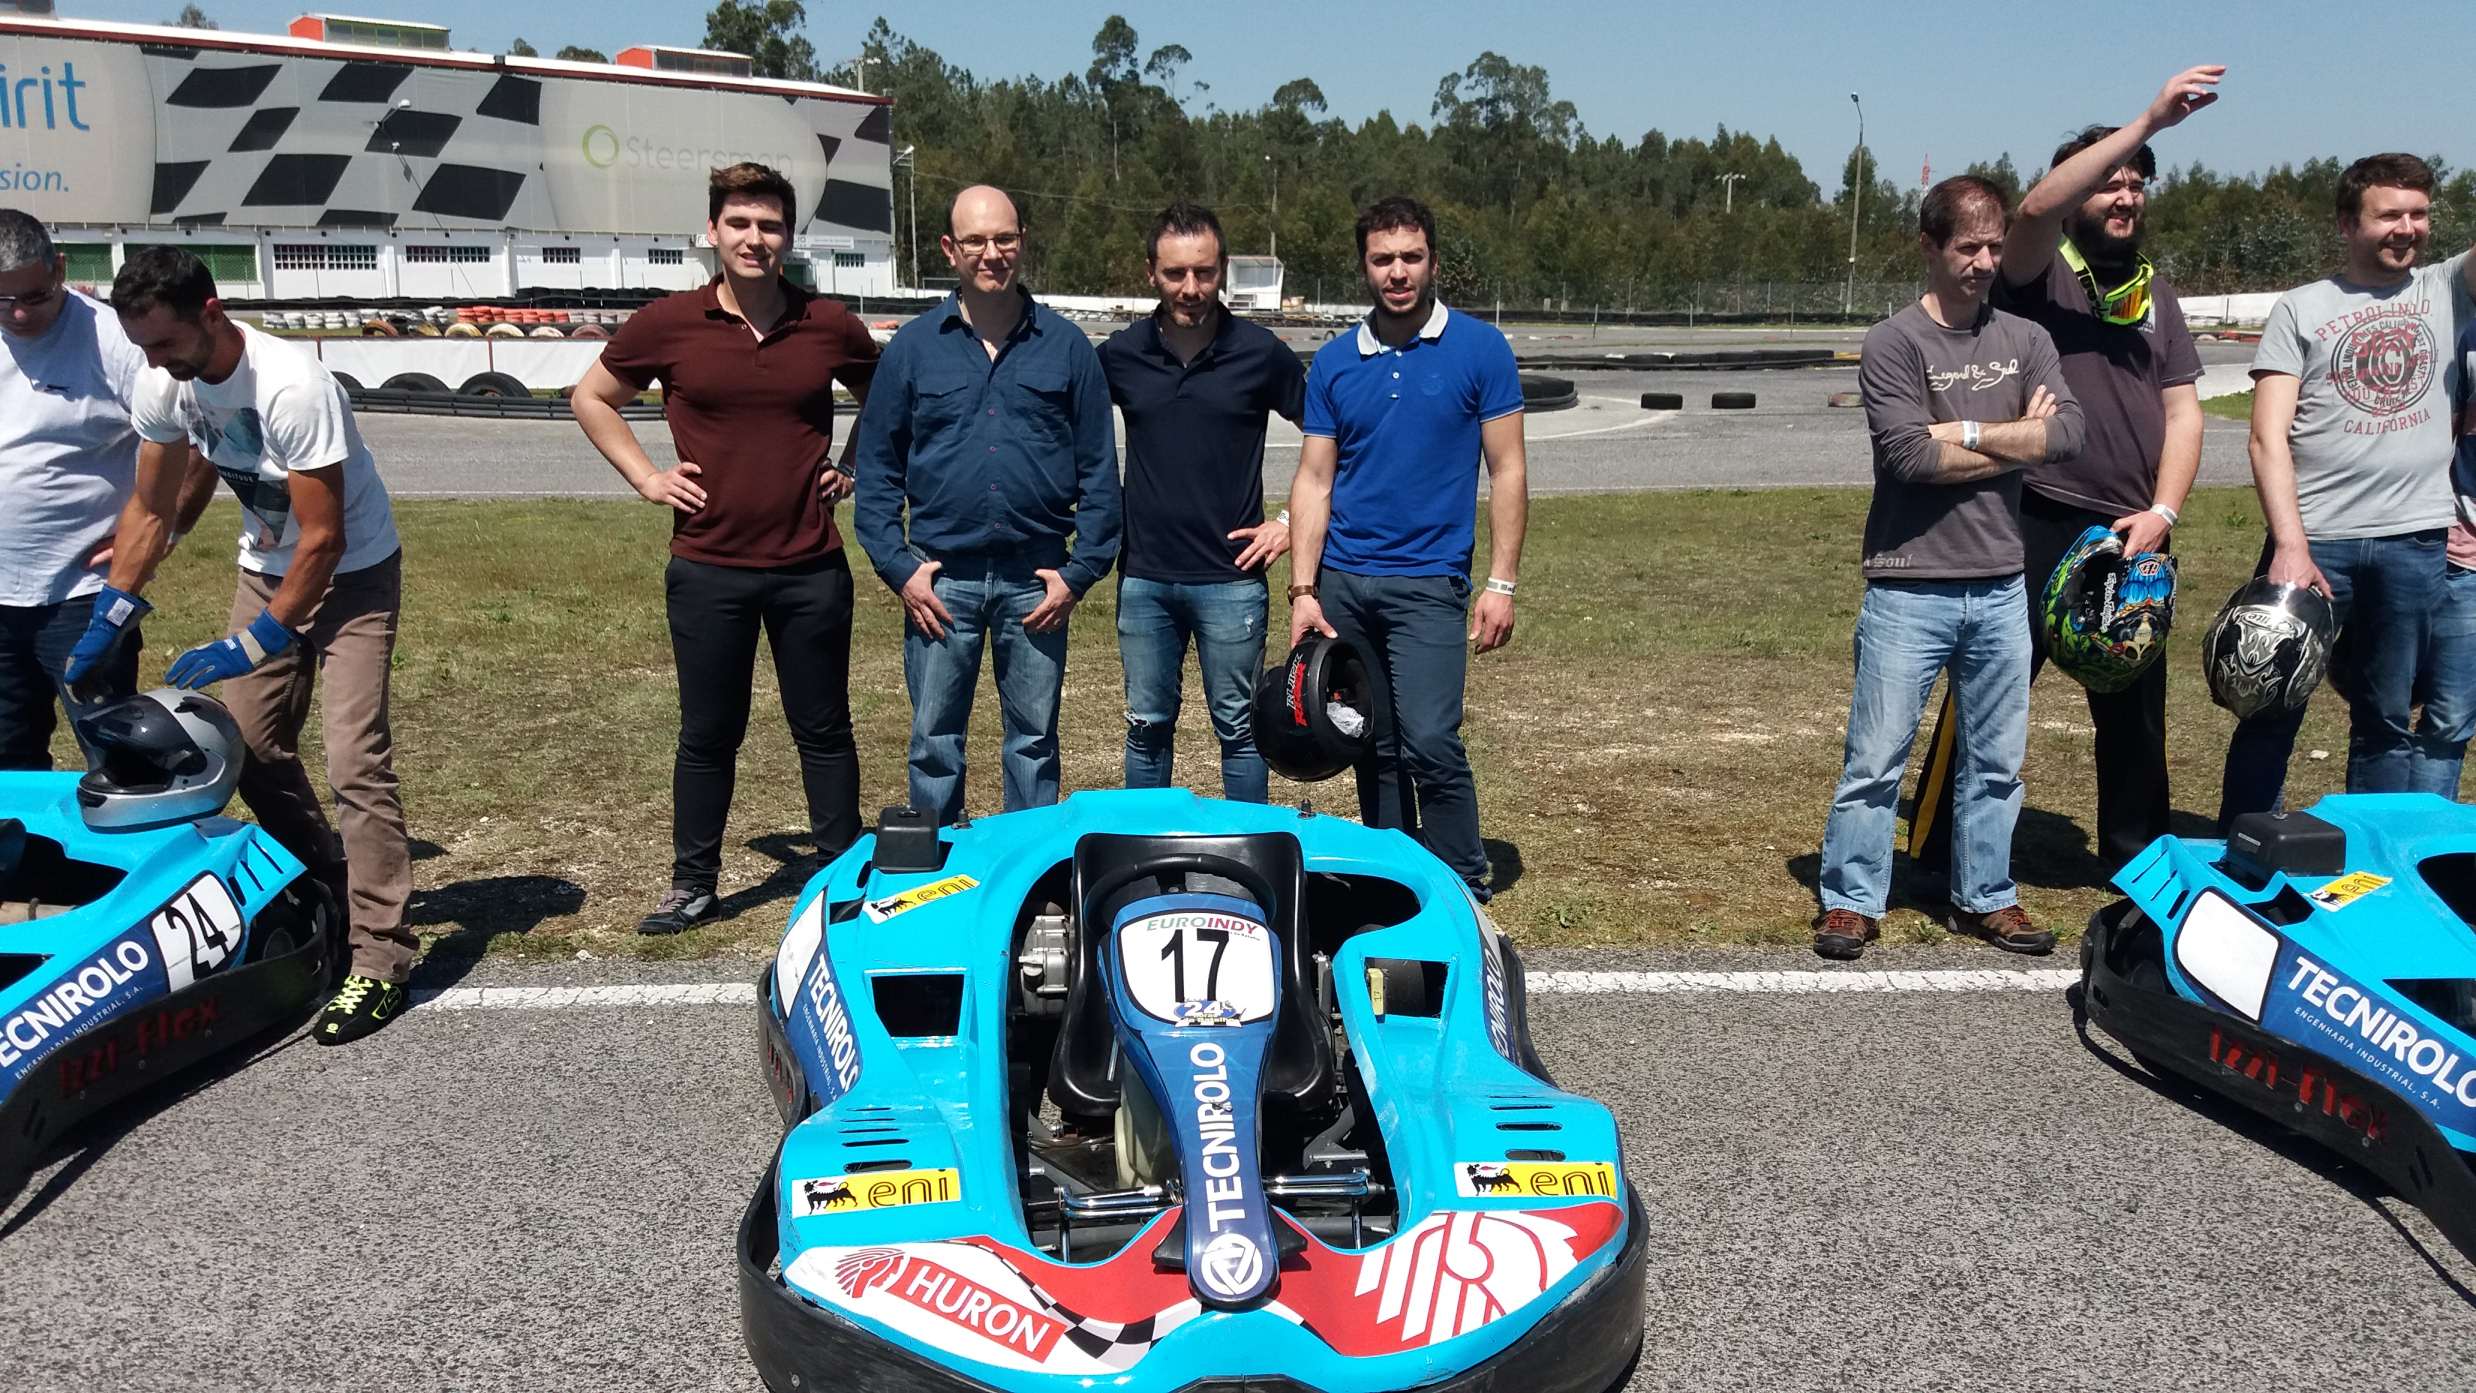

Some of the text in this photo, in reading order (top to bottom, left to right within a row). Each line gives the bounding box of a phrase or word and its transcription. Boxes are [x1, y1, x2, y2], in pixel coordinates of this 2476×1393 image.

[2343, 408, 2431, 435] CALIFORNIA
[917, 876, 976, 902] eni
[1146, 916, 1259, 935] EUROINDY
[164, 892, 231, 981] 24
[1161, 928, 1230, 1003] 17
[1485, 948, 1510, 1058] ECNIROLO
[2294, 1006, 2354, 1051] ENGENHARIA
[2419, 1090, 2441, 1110] S.A.
[1190, 1042, 1246, 1232] TECNIROLO
[868, 1168, 949, 1209] eni
[1530, 1162, 1611, 1196] eni
[905, 1265, 1051, 1353] HURON
